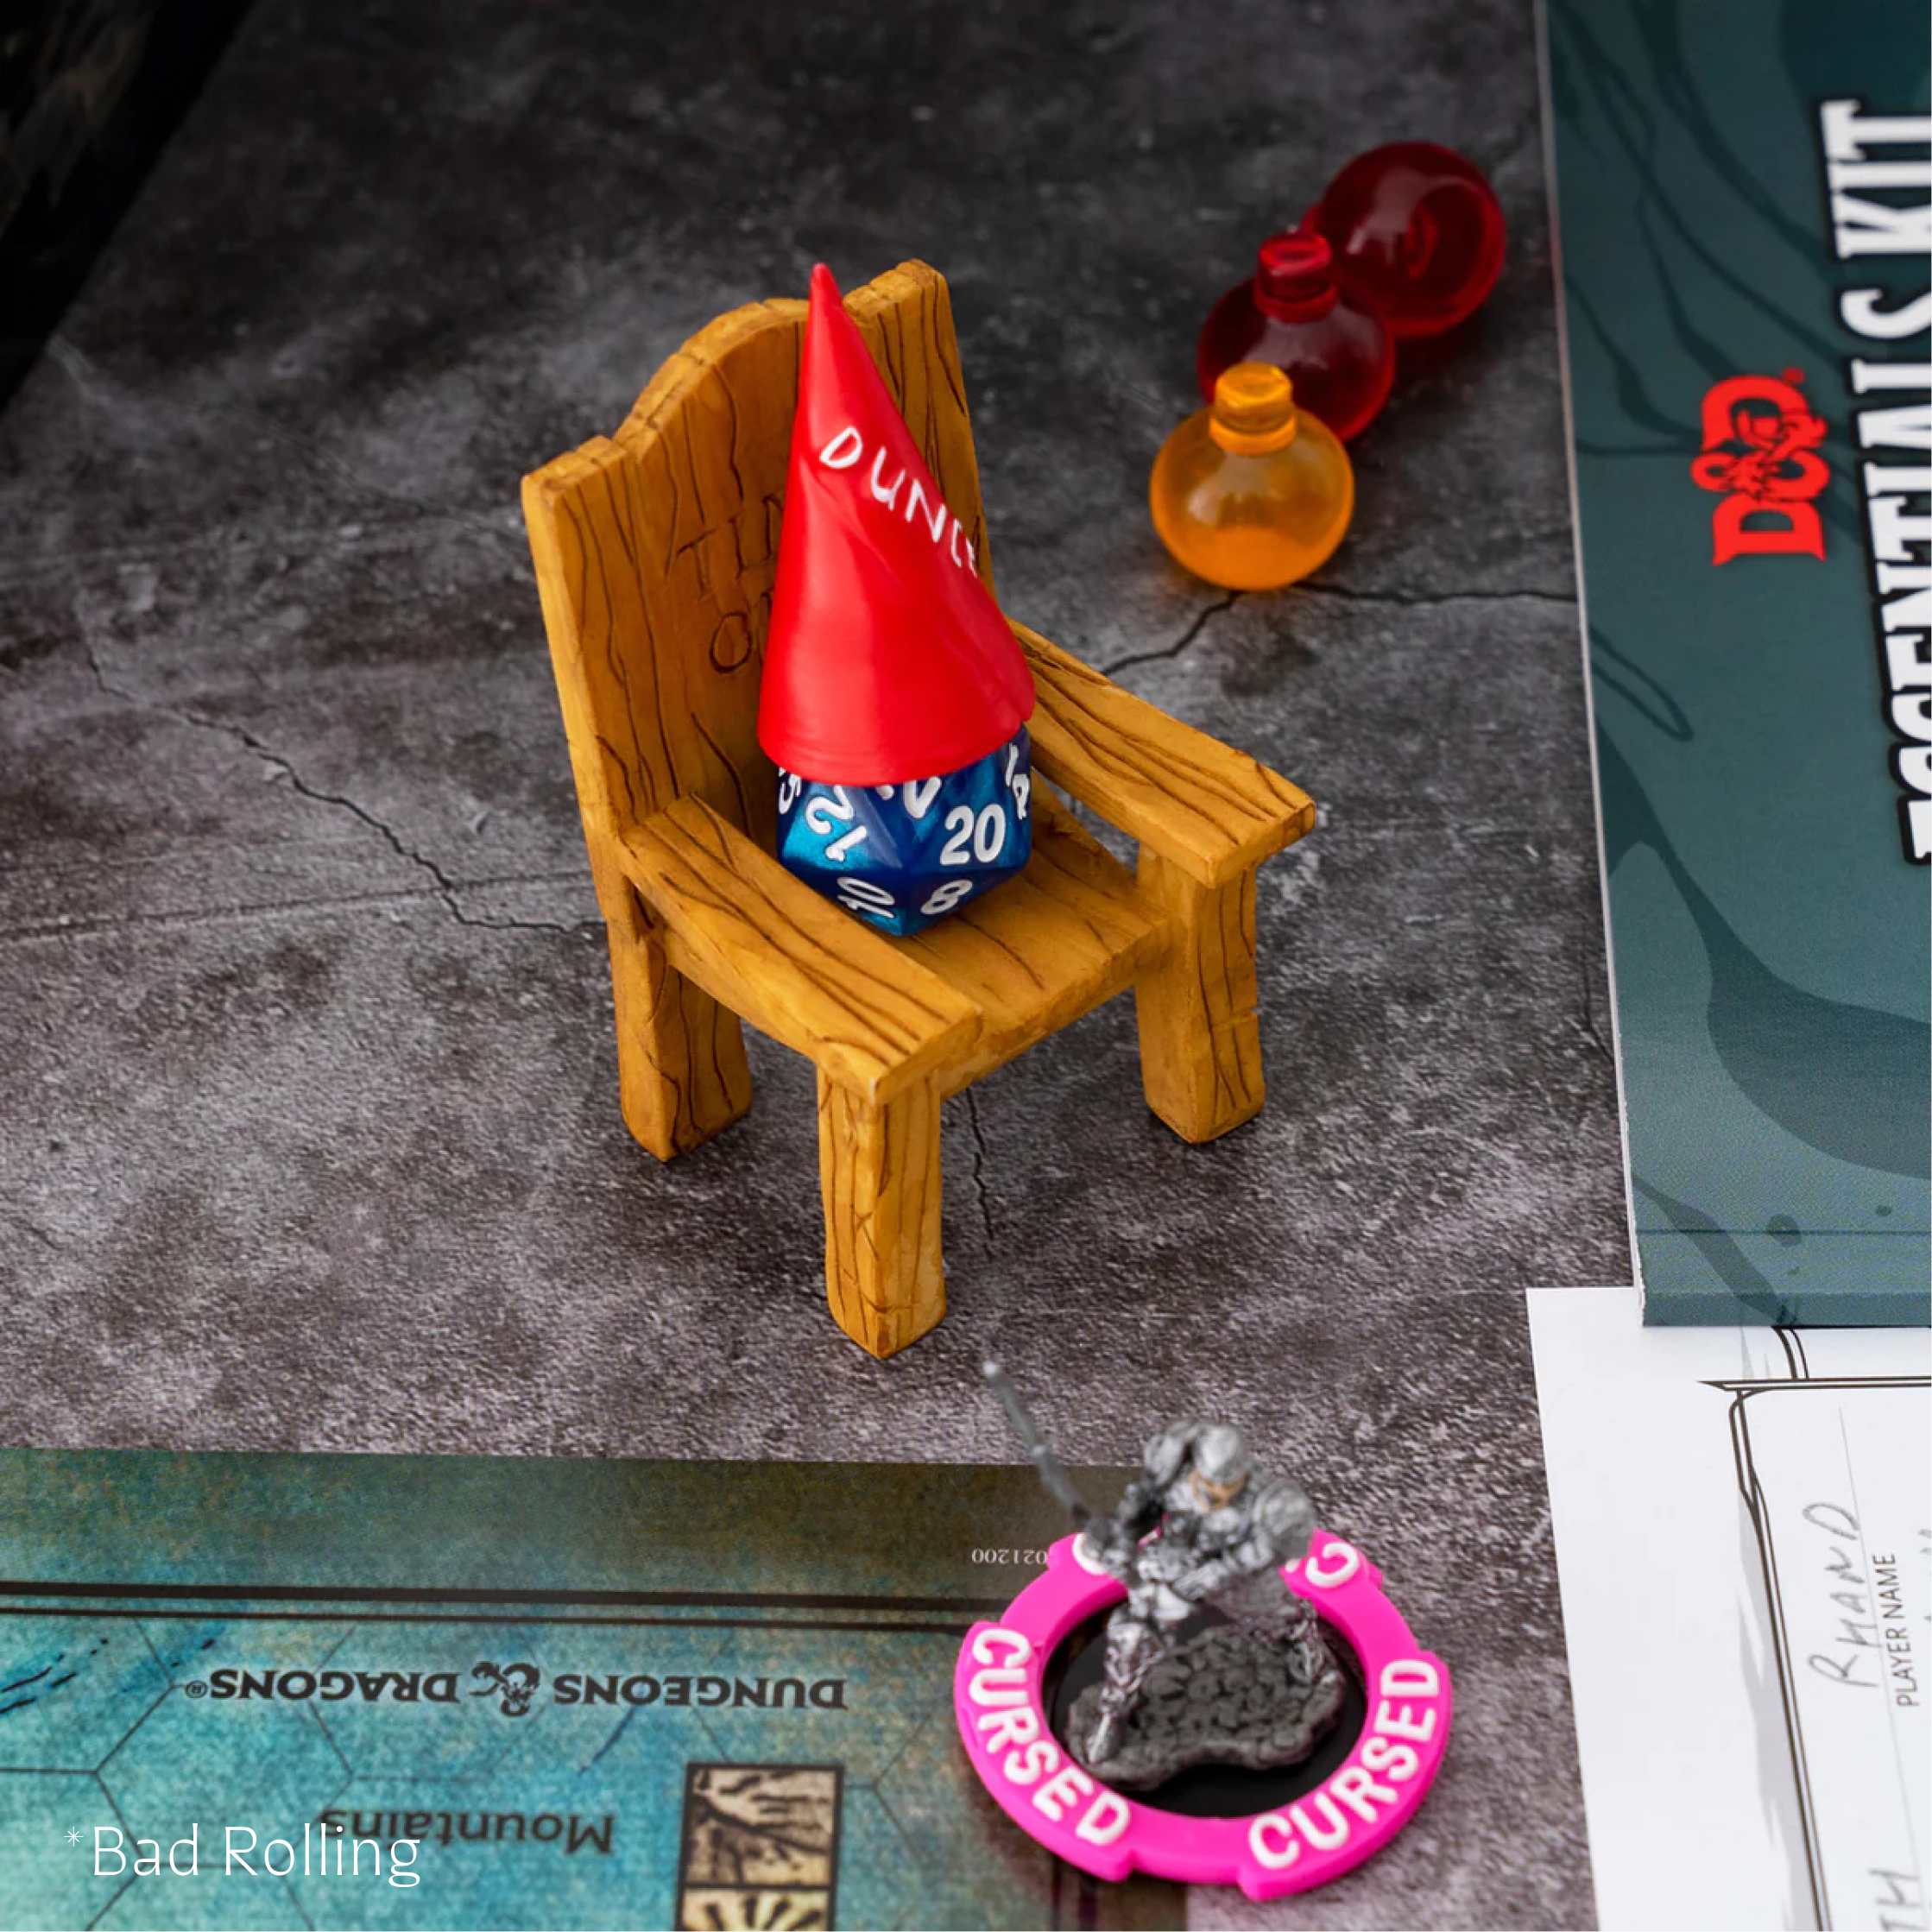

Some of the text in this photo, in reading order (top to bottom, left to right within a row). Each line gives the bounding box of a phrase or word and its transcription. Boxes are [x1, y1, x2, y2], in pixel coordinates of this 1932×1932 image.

[1820, 99, 1932, 259] KIT
[939, 803, 1007, 866] 20
[920, 879, 973, 915] 8
[1872, 1553, 1921, 1708] PLAYER NAME
[552, 1673, 849, 1711] DUNGEONS
[968, 1627, 1131, 1847] CURSED
[1247, 1657, 1441, 1869] CURSED
[318, 1808, 616, 1857] Mountains
